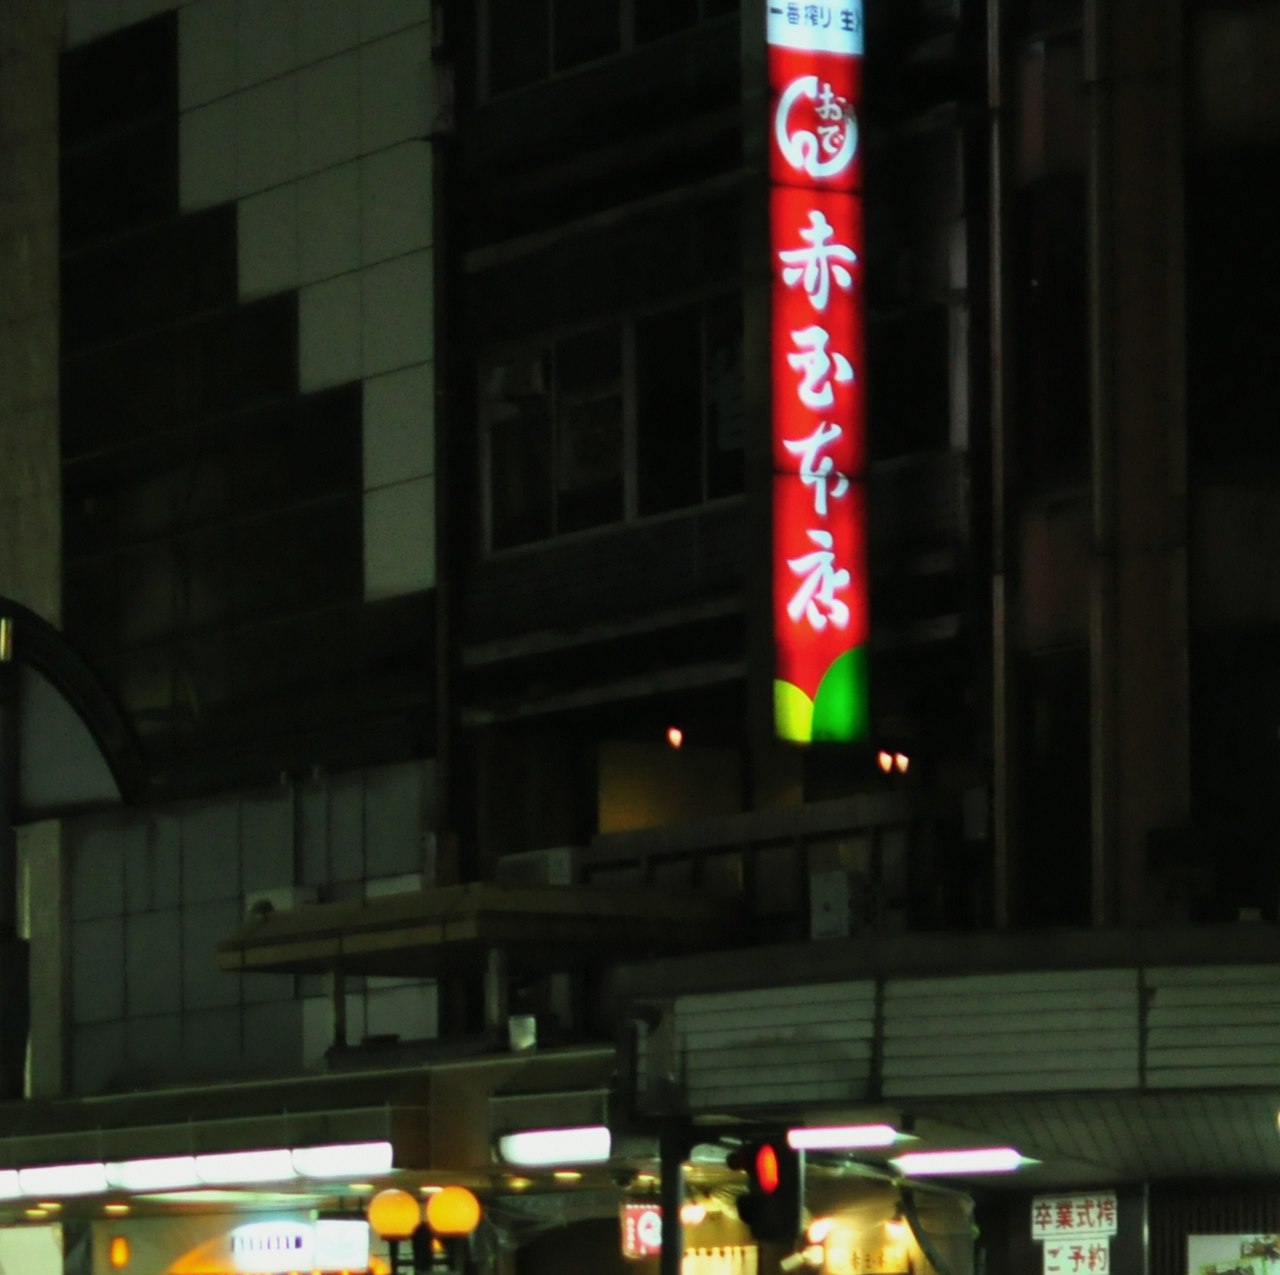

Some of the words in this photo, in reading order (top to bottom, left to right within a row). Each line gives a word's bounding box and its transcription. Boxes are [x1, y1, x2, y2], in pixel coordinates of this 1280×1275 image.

[778, 210, 857, 632] 赤玉本店
[1034, 1198, 1116, 1231] 卒業式袴
[1047, 1243, 1108, 1273] ご予約
